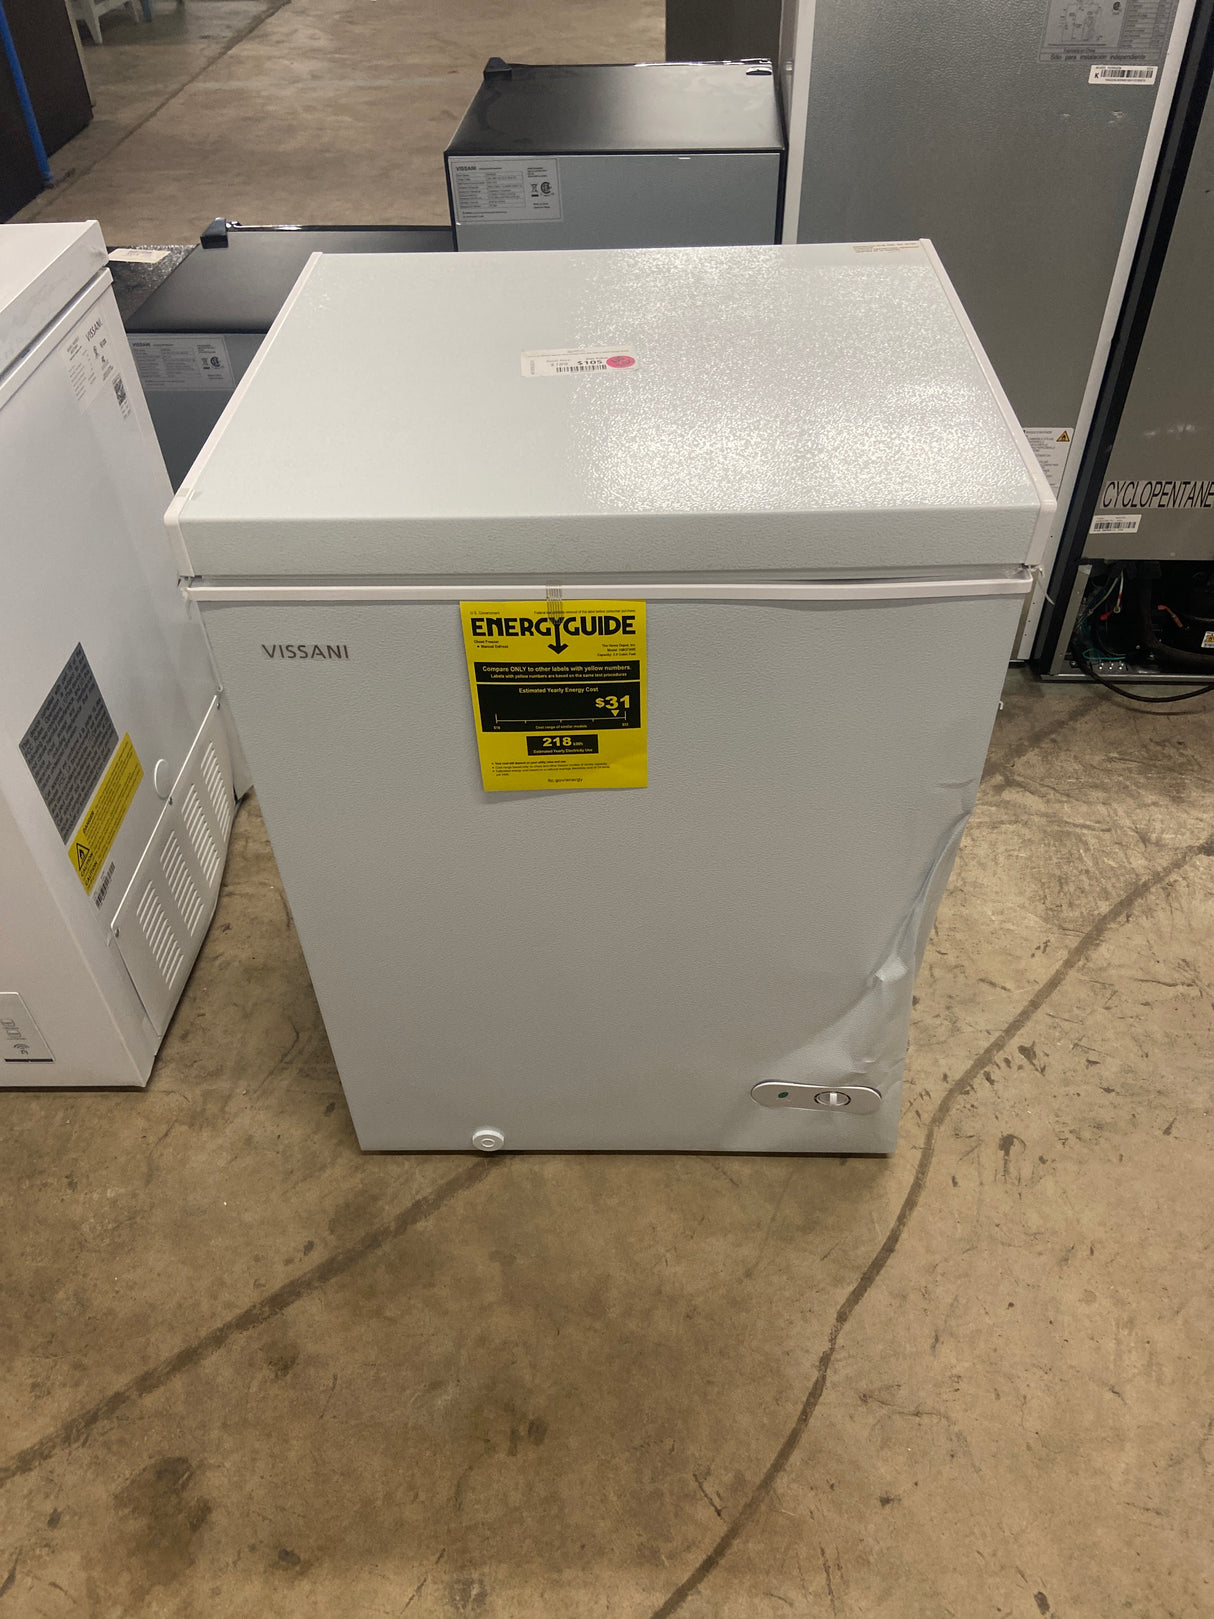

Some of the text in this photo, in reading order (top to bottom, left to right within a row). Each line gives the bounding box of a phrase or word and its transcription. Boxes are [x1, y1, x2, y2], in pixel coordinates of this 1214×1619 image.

[1102, 481, 1214, 508] CYCLOPENTANE
[261, 644, 349, 659] VISSANI
[482, 665, 509, 673] Compare
[584, 665, 603, 673] yellow
[595, 695, 630, 709] $31
[542, 737, 572, 747] 218
